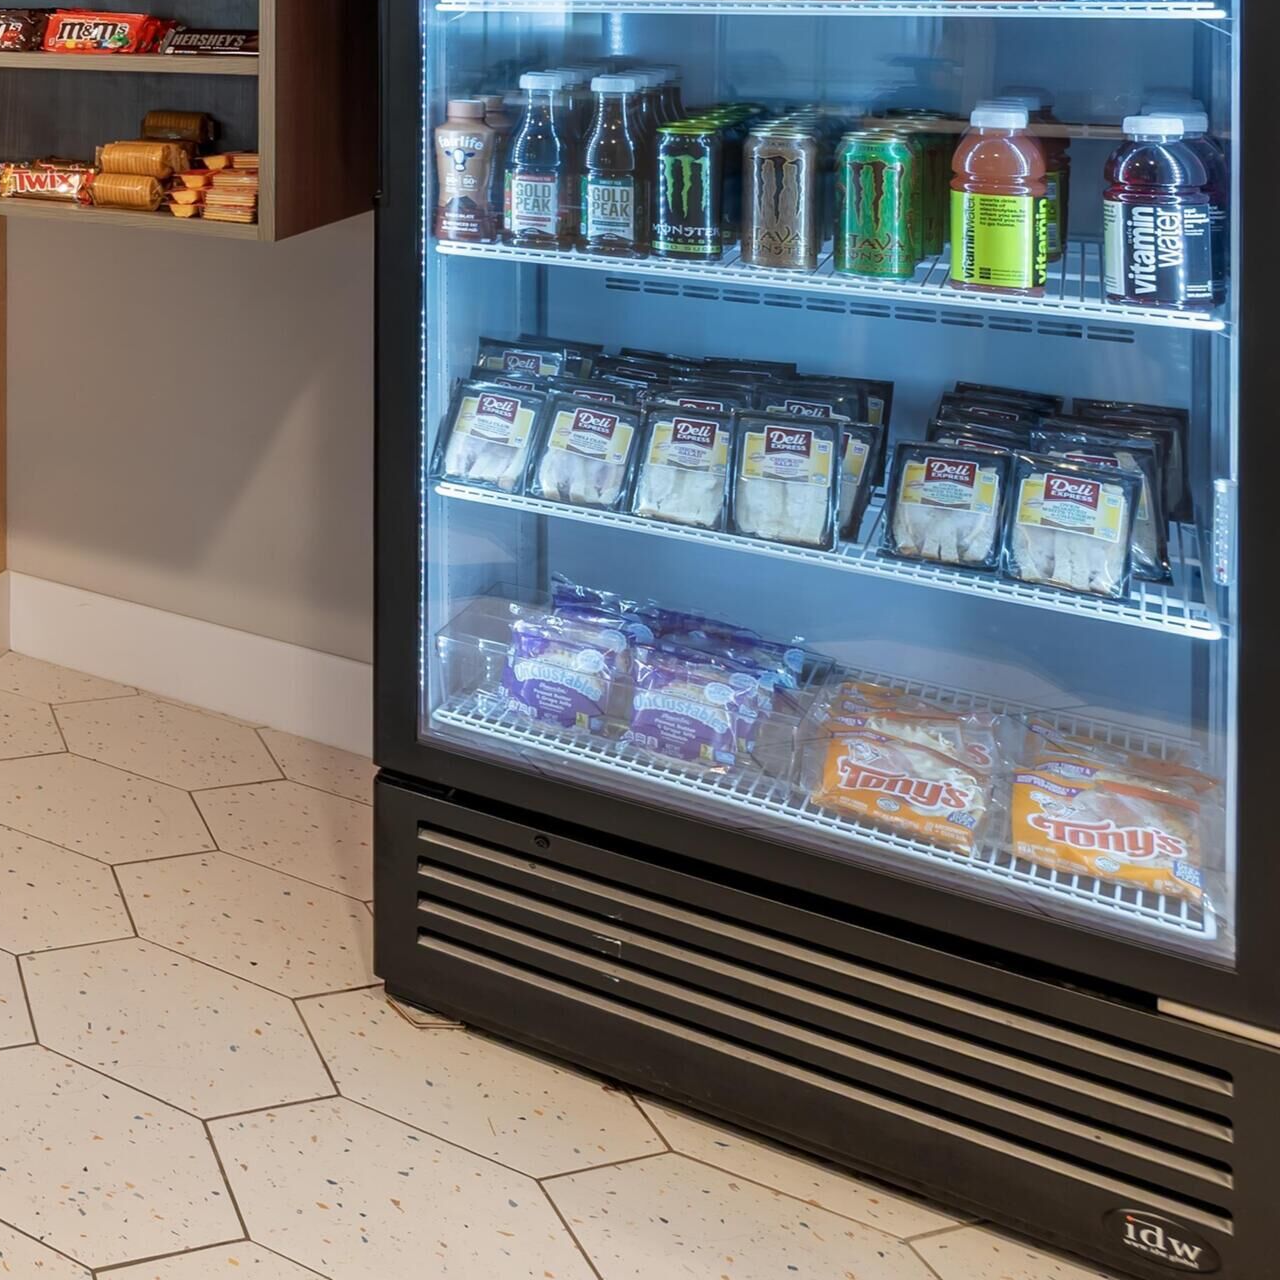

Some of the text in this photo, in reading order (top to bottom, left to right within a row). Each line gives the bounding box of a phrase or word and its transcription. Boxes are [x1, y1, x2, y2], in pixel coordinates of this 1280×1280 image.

[171, 34, 246, 46] HERSHEY'S
[438, 135, 484, 150] fairlife
[15, 170, 78, 192] Twix
[516, 183, 551, 198] GOLD
[592, 187, 630, 202] GOLD
[516, 197, 551, 212] PEAK
[592, 202, 630, 217] PEAK
[1034, 198, 1047, 284] vitamin
[1155, 207, 1184, 268] water
[1128, 206, 1157, 294] vitamin
[483, 397, 514, 411] Deli
[482, 406, 512, 418] EXPRESS
[579, 412, 611, 428] Deli
[578, 422, 610, 434] EXPRESS
[677, 422, 711, 437] Deli
[677, 433, 710, 443] EXPRESS
[770, 430, 805, 445] Deli
[771, 443, 807, 451] EXPRESS
[930, 461, 970, 476] Deli
[931, 472, 970, 481] EXPRESS
[1050, 478, 1093, 496] Deli
[1050, 491, 1093, 503] EXPRESS
[837, 755, 970, 810] Tony's
[1027, 813, 1188, 860] Tony's
[1125, 1215, 1202, 1261] idw
